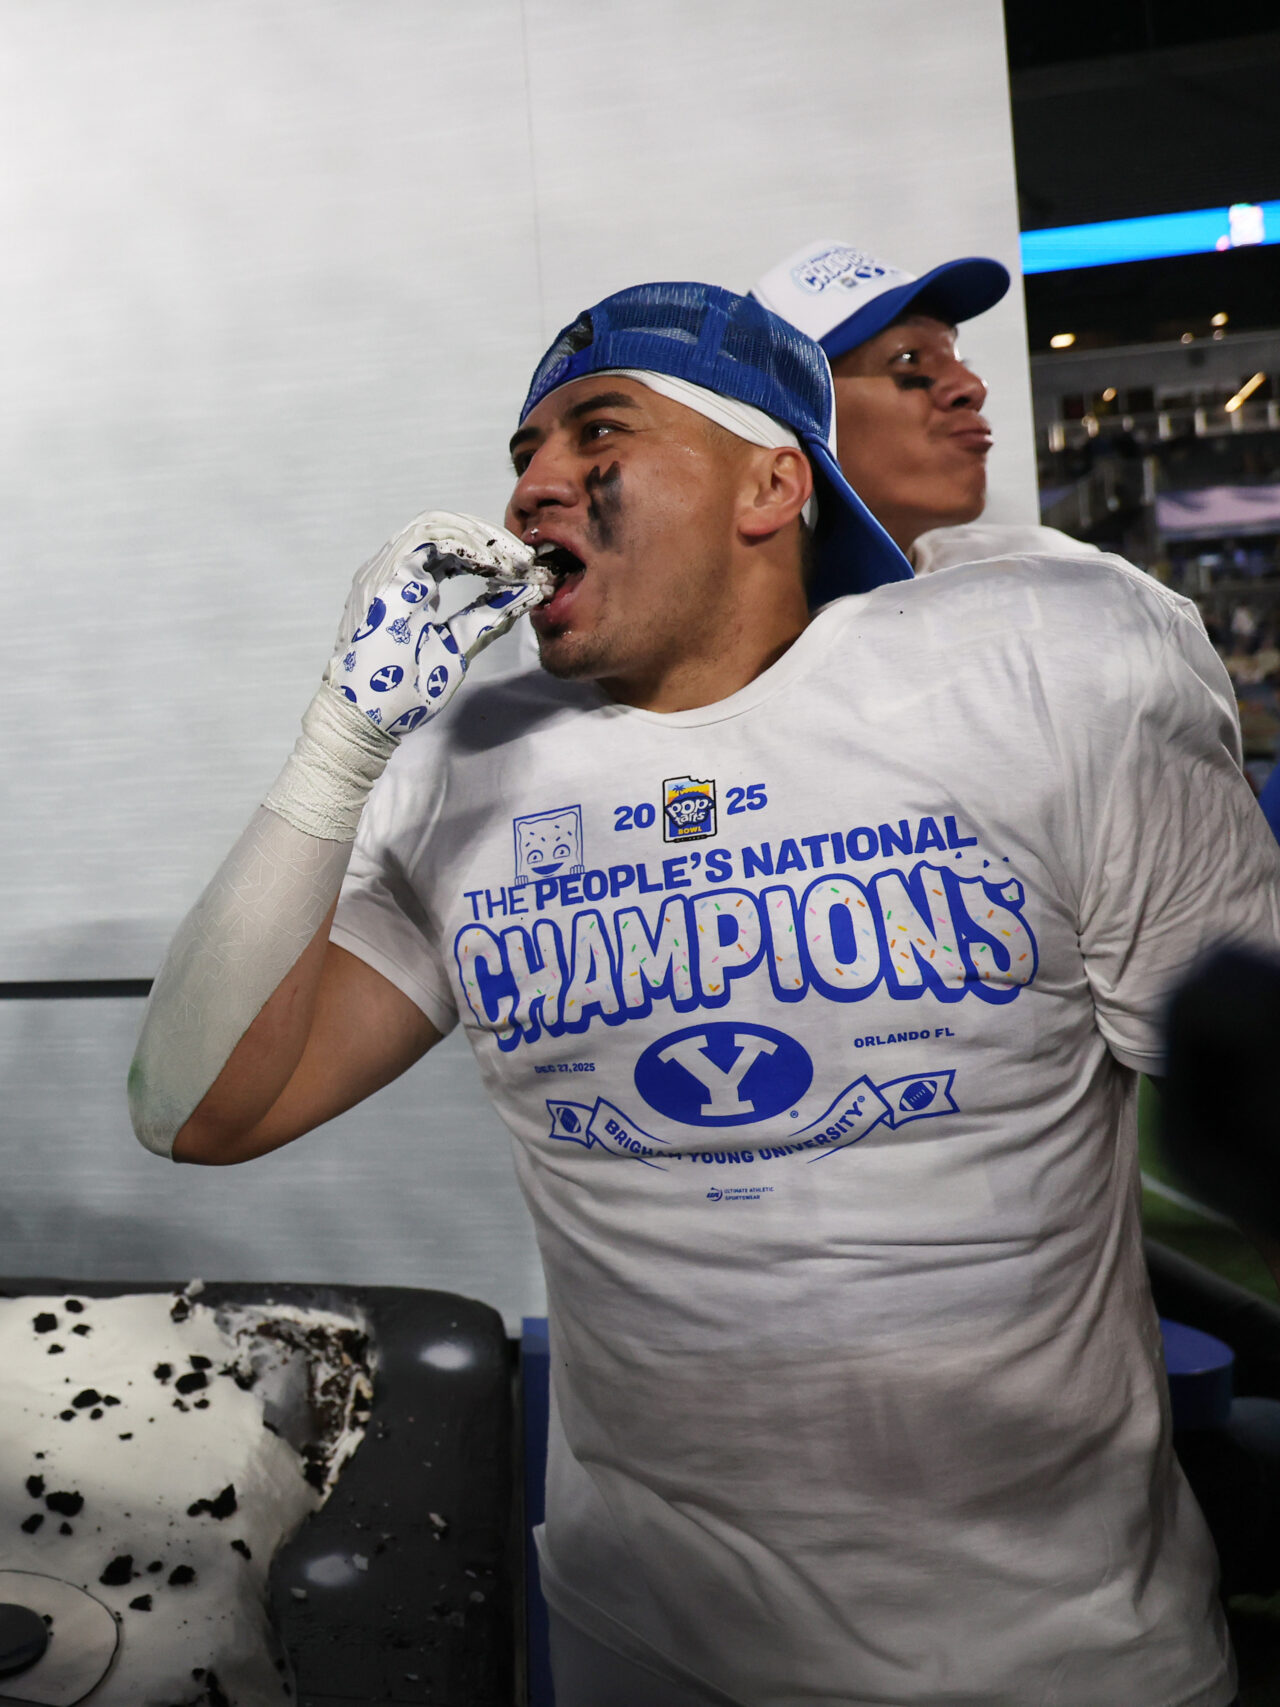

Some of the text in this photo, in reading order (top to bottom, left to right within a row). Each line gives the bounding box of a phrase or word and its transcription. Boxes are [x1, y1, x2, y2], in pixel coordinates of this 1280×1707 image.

[613, 783, 768, 832] 20 25
[678, 826, 703, 835] BOWL
[463, 816, 978, 921] THE PEOPLE'S NATIONAL
[454, 860, 1039, 1053] CHAMPIONS
[854, 1027, 955, 1048] ORLANDO FL
[657, 1031, 780, 1117] Y
[604, 1101, 864, 1164] BRIGHAM YOUNG UNIVERSITY
